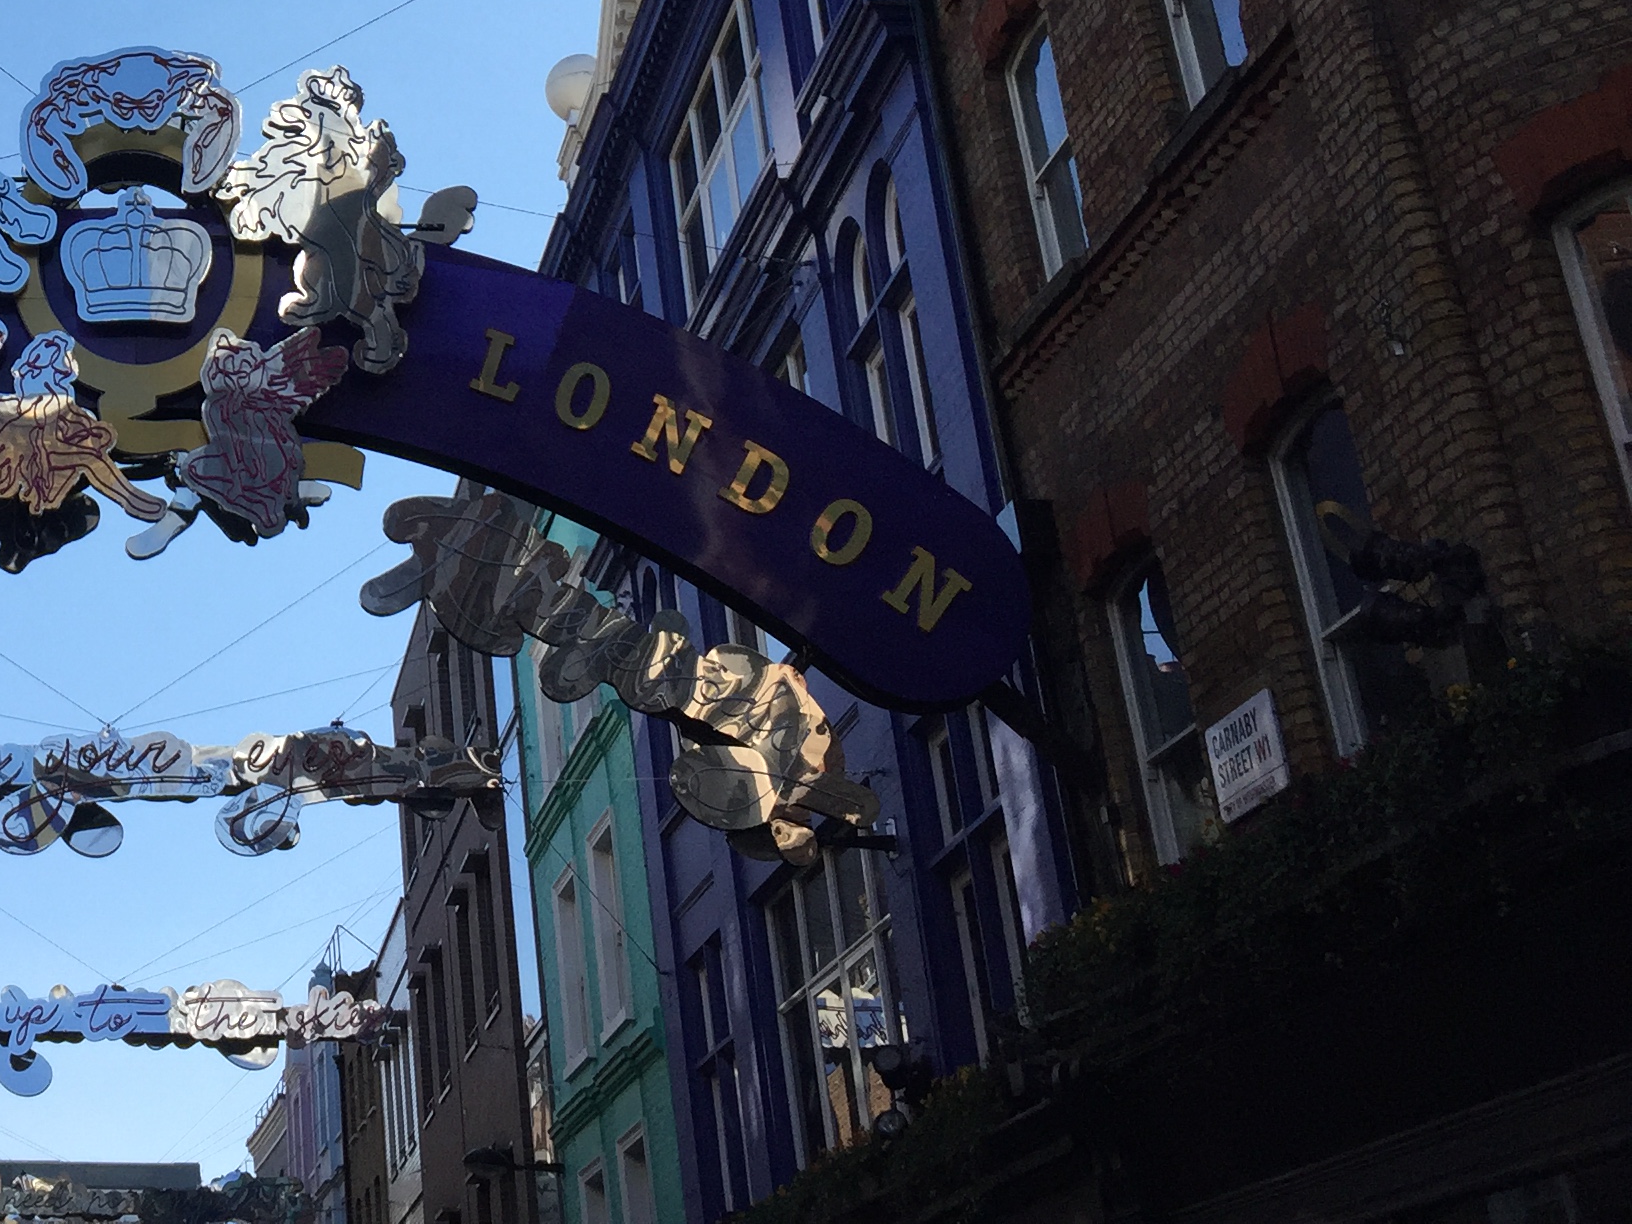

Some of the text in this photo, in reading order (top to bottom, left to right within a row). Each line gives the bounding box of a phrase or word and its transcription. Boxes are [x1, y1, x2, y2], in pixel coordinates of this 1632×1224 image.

[469, 327, 973, 633] LONDON
[1211, 706, 1258, 759] CARNABY
[1218, 733, 1273, 789] STREET W1
[1, 737, 213, 843] your
[229, 739, 408, 846] eyes
[4, 1002, 60, 1046] up
[77, 984, 165, 1033] to
[184, 985, 278, 1033] the
